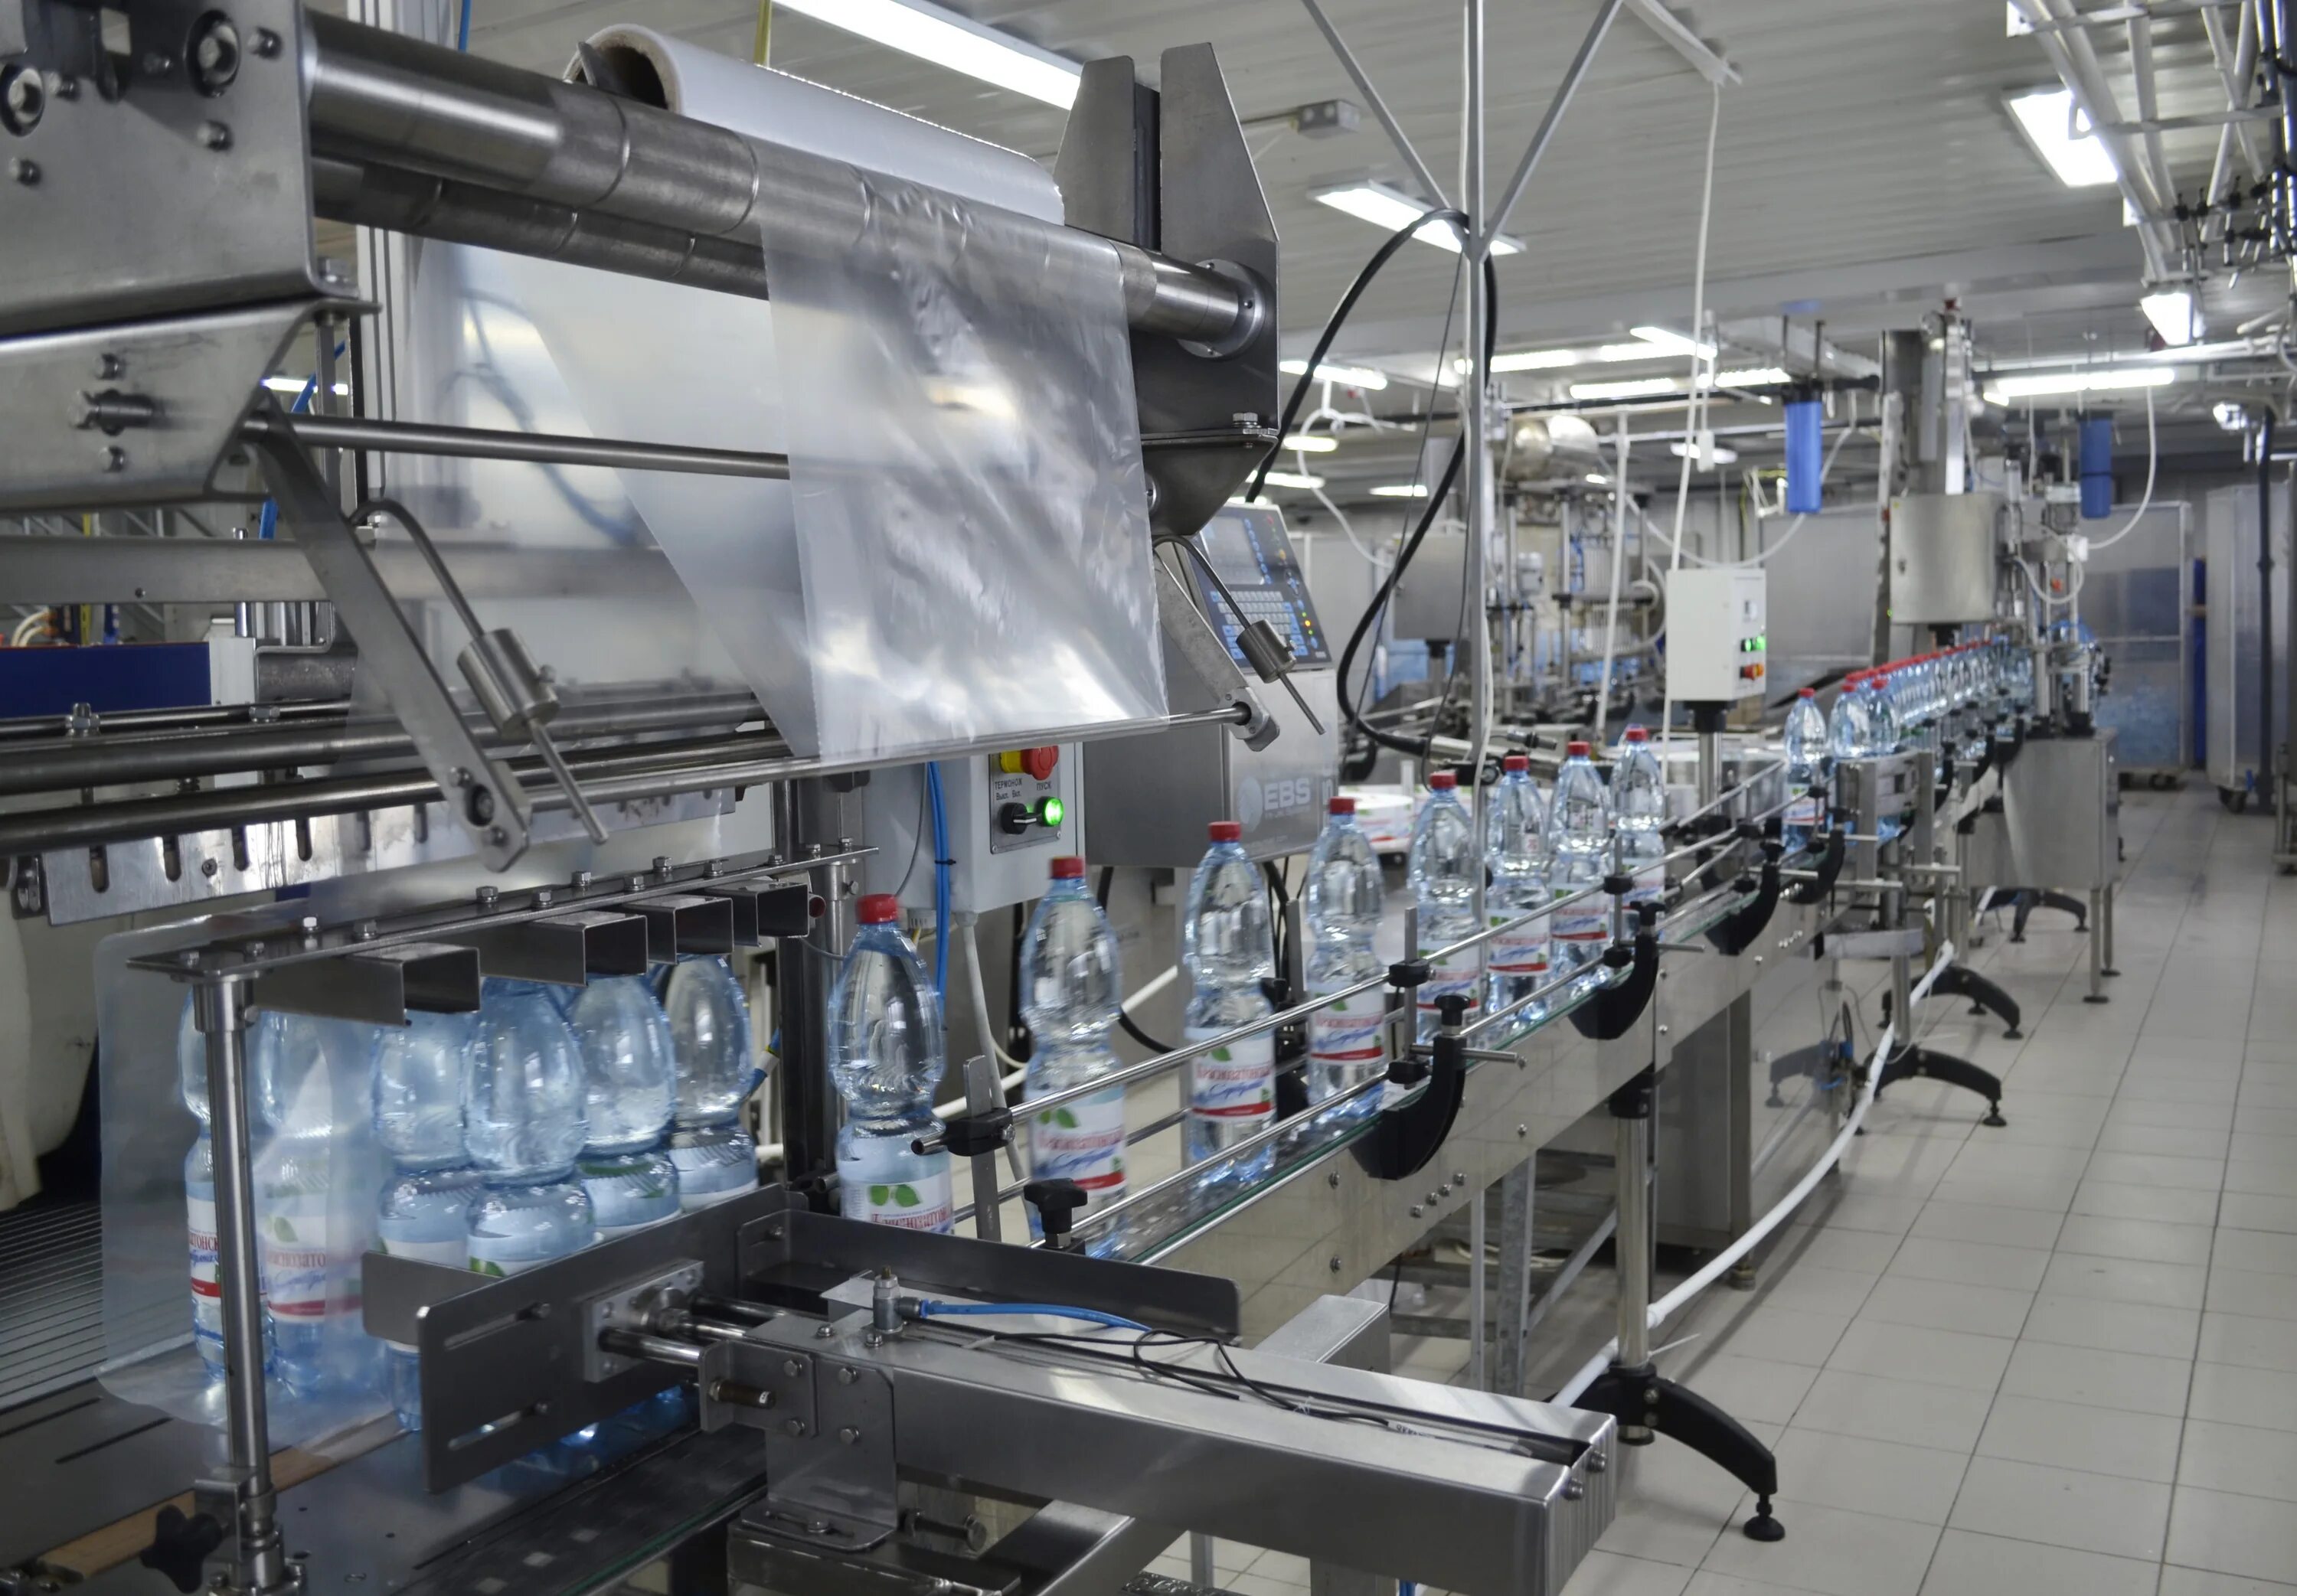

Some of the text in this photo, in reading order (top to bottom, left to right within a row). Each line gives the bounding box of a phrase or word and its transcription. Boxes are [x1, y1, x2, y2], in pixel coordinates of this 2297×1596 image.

[995, 778, 1023, 790] ТЕРМОНОЖ
[1036, 781, 1052, 791] ПУСК
[1264, 777, 1311, 811] EBS
